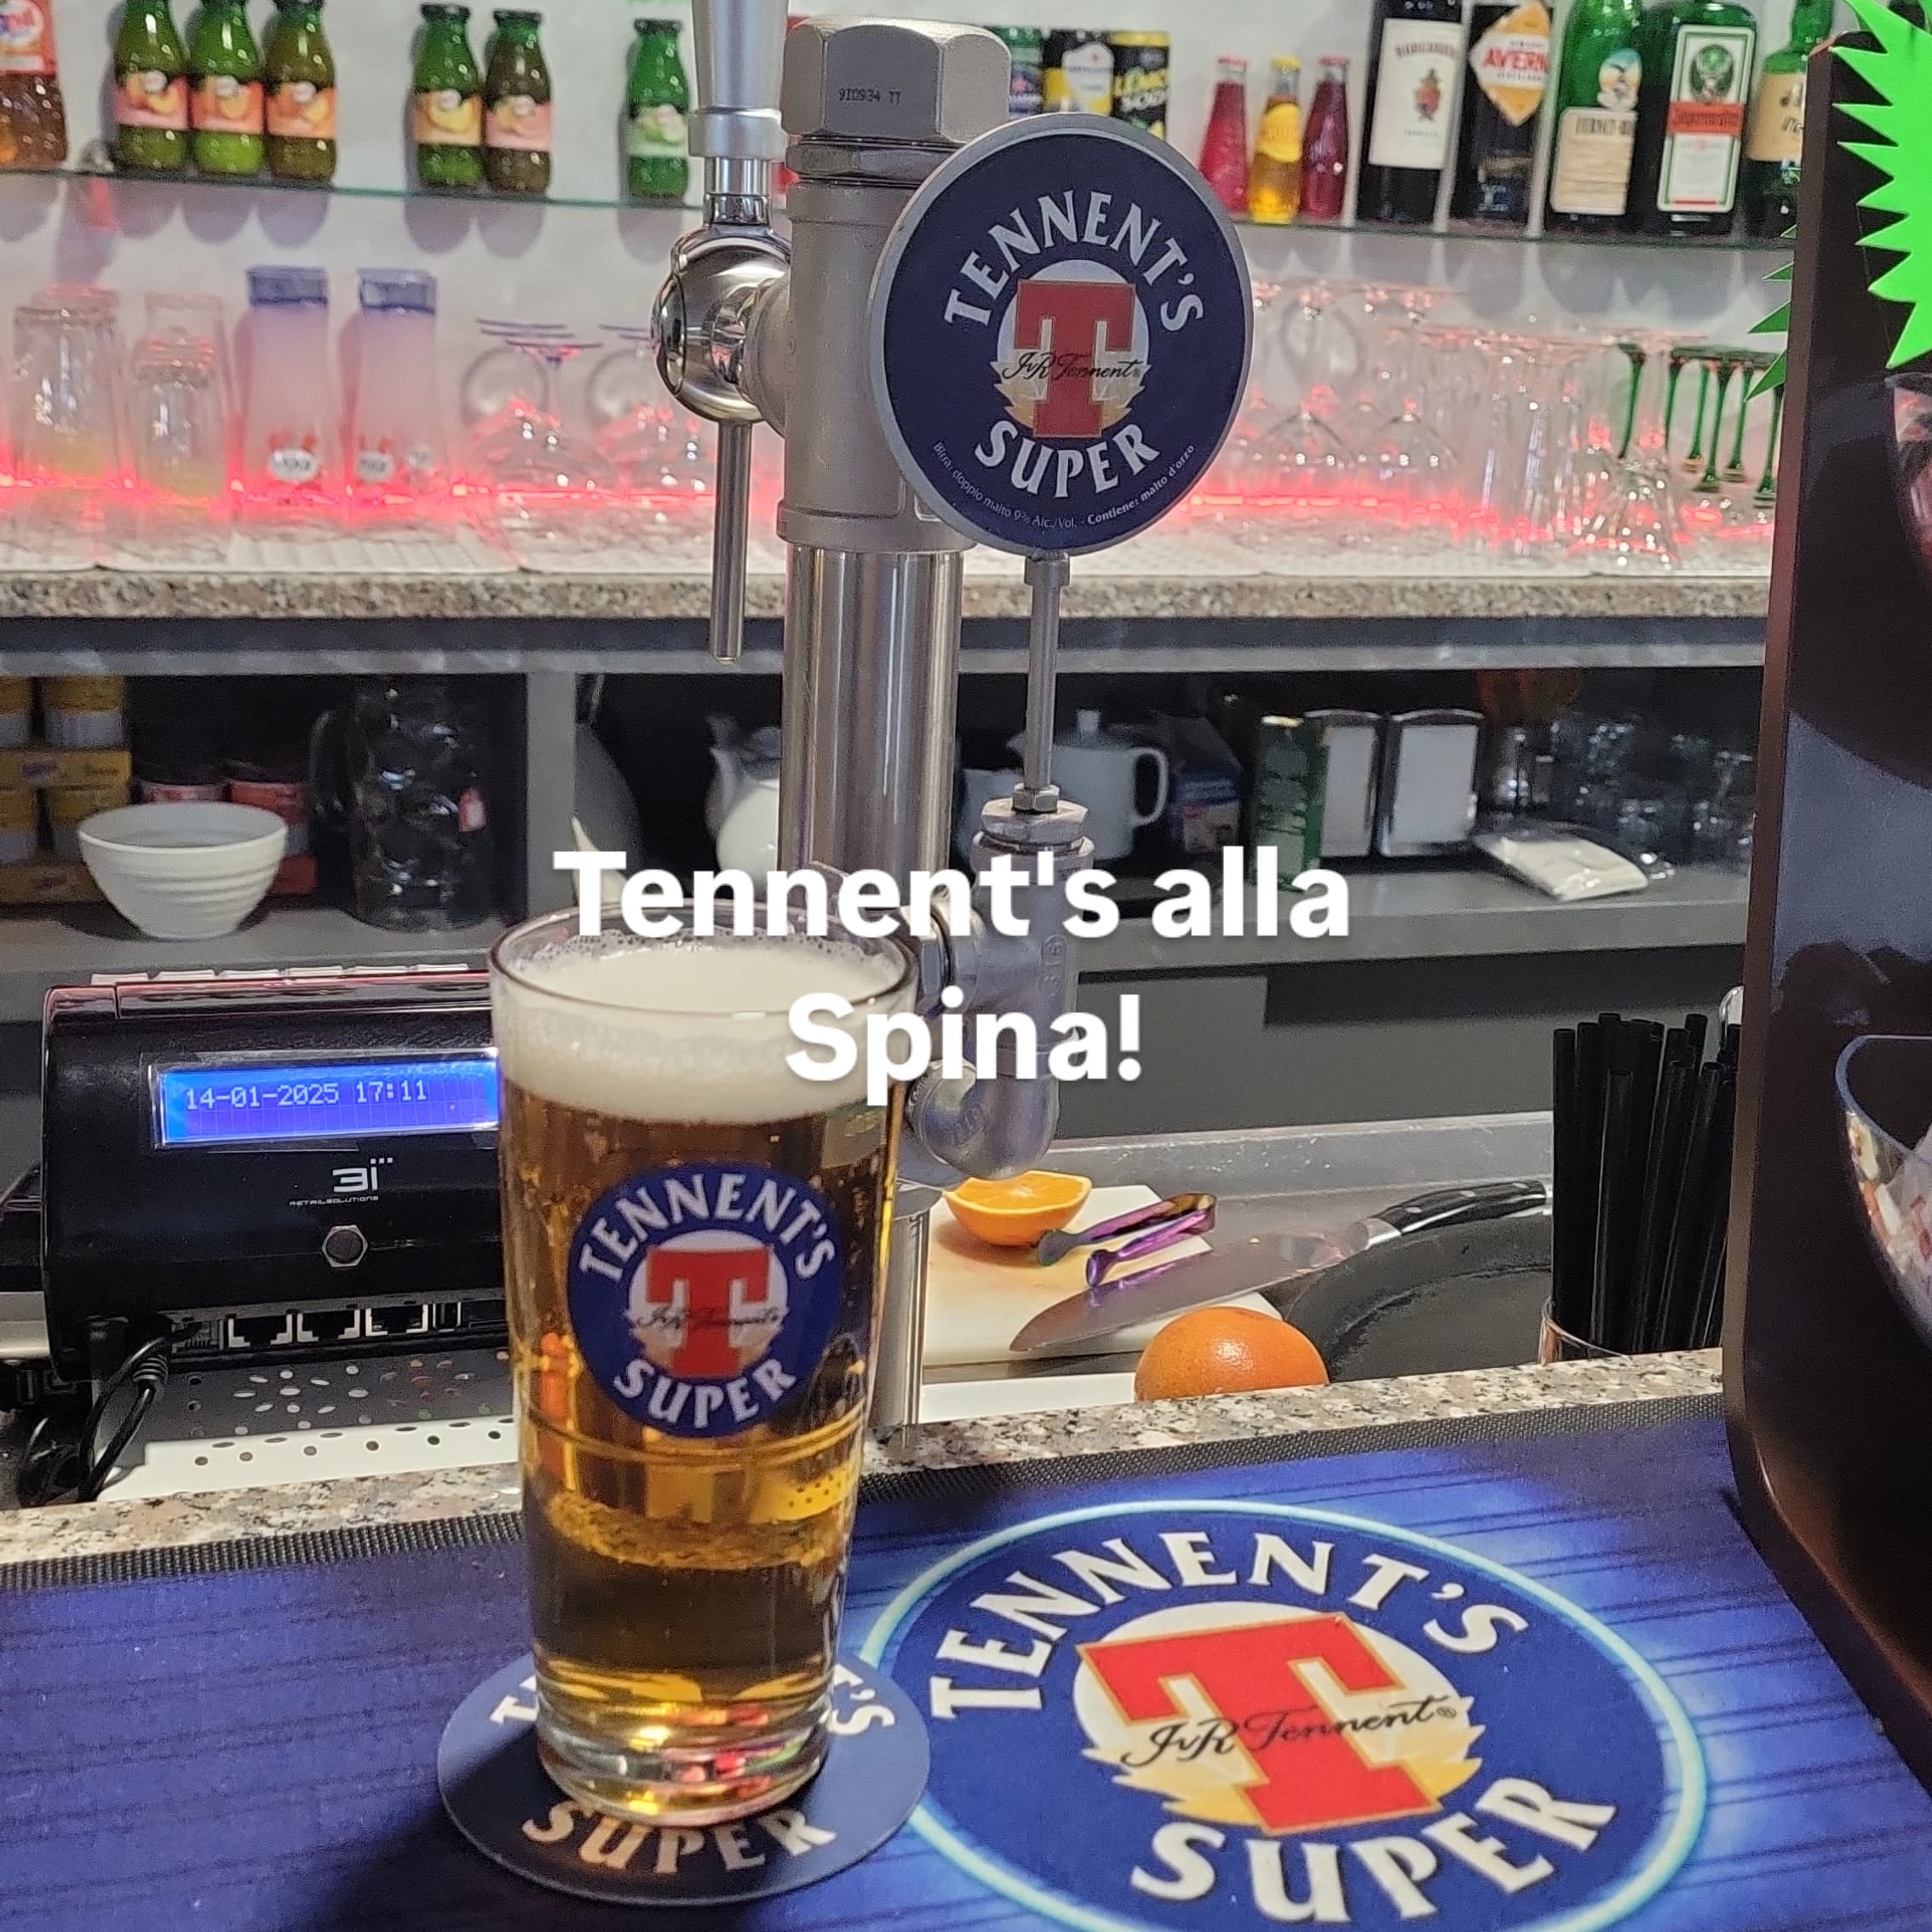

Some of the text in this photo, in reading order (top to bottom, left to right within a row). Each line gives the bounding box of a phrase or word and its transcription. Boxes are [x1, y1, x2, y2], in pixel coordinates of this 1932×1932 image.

[943, 189, 1205, 332] TENNENT'S
[1014, 279, 1136, 439] T
[952, 469, 983, 501] doppio
[982, 496, 1012, 518] malto
[1087, 499, 1140, 525] Contiene:
[1140, 475, 1169, 502] malto
[1168, 445, 1194, 478] d'orzo
[974, 419, 1160, 497] SUPER
[186, 1078, 428, 1111] 14-01-2025 17:11
[578, 1172, 836, 1282] TENNENT'S
[646, 1247, 770, 1378] T
[613, 1359, 796, 1429] SUPER
[929, 1531, 1528, 1720] TENNENT'S
[1076, 1613, 1441, 1837] T
[521, 1800, 837, 1874] SUPER
[1130, 1776, 1617, 1925] SUPER
